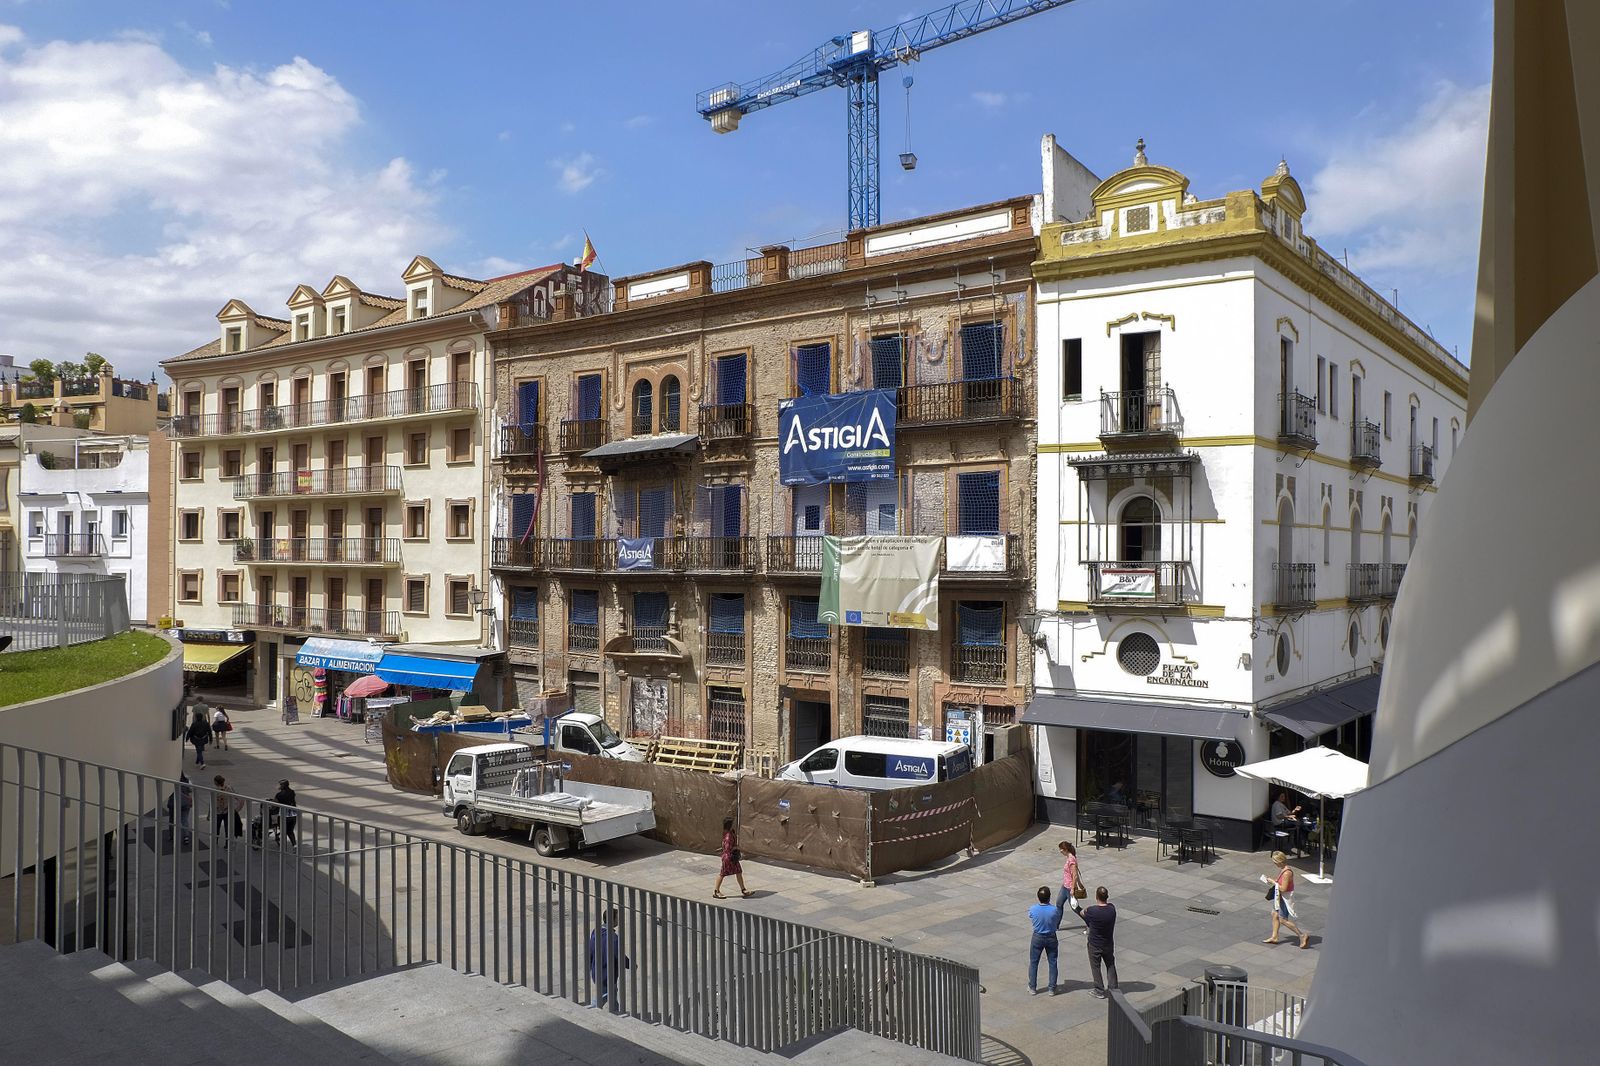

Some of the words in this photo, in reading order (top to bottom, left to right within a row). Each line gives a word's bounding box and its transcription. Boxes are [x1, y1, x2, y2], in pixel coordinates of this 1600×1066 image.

[784, 407, 890, 455] ASTIGIA
[618, 544, 652, 559] ASTIGIA
[299, 655, 321, 667] BAZAR
[322, 658, 327, 667] Y
[328, 659, 375, 673] ALIMENTACION
[1162, 664, 1192, 673] PLAZA
[895, 760, 928, 774] ASTIGIA
